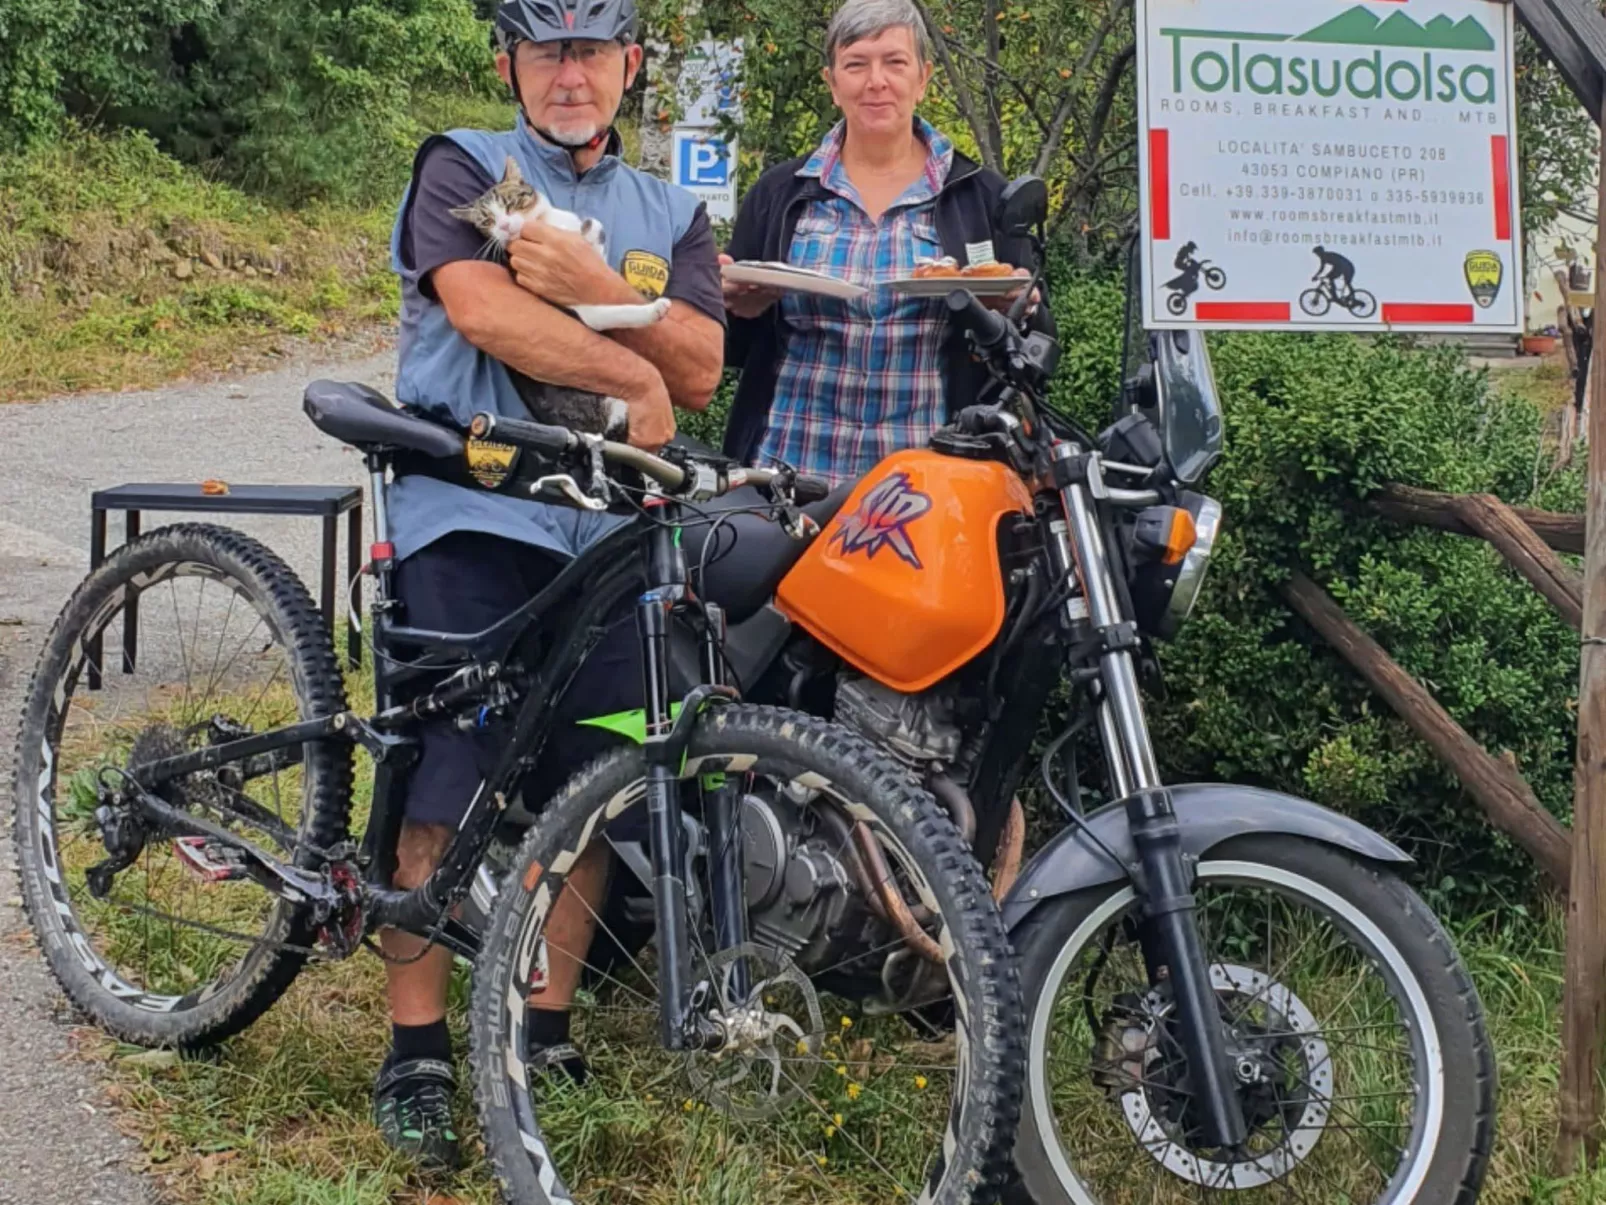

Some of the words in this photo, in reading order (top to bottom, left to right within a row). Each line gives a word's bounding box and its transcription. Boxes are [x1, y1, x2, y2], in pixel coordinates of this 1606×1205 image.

[1160, 28, 1495, 104] Tolasudolsa
[1161, 99, 1240, 116] ROOMS,
[1254, 102, 1371, 119] BREAKFAST
[1459, 111, 1497, 124] MTB
[1312, 143, 1412, 160] SAMBUCETO
[689, 143, 719, 181] P
[1242, 163, 1288, 177] 43053
[1297, 165, 1383, 180] COMPIANO
[1391, 167, 1425, 183] (PR)
[1179, 182, 1217, 197] Cell.
[1230, 208, 1439, 225] www.roomsbreakfastmtb.it
